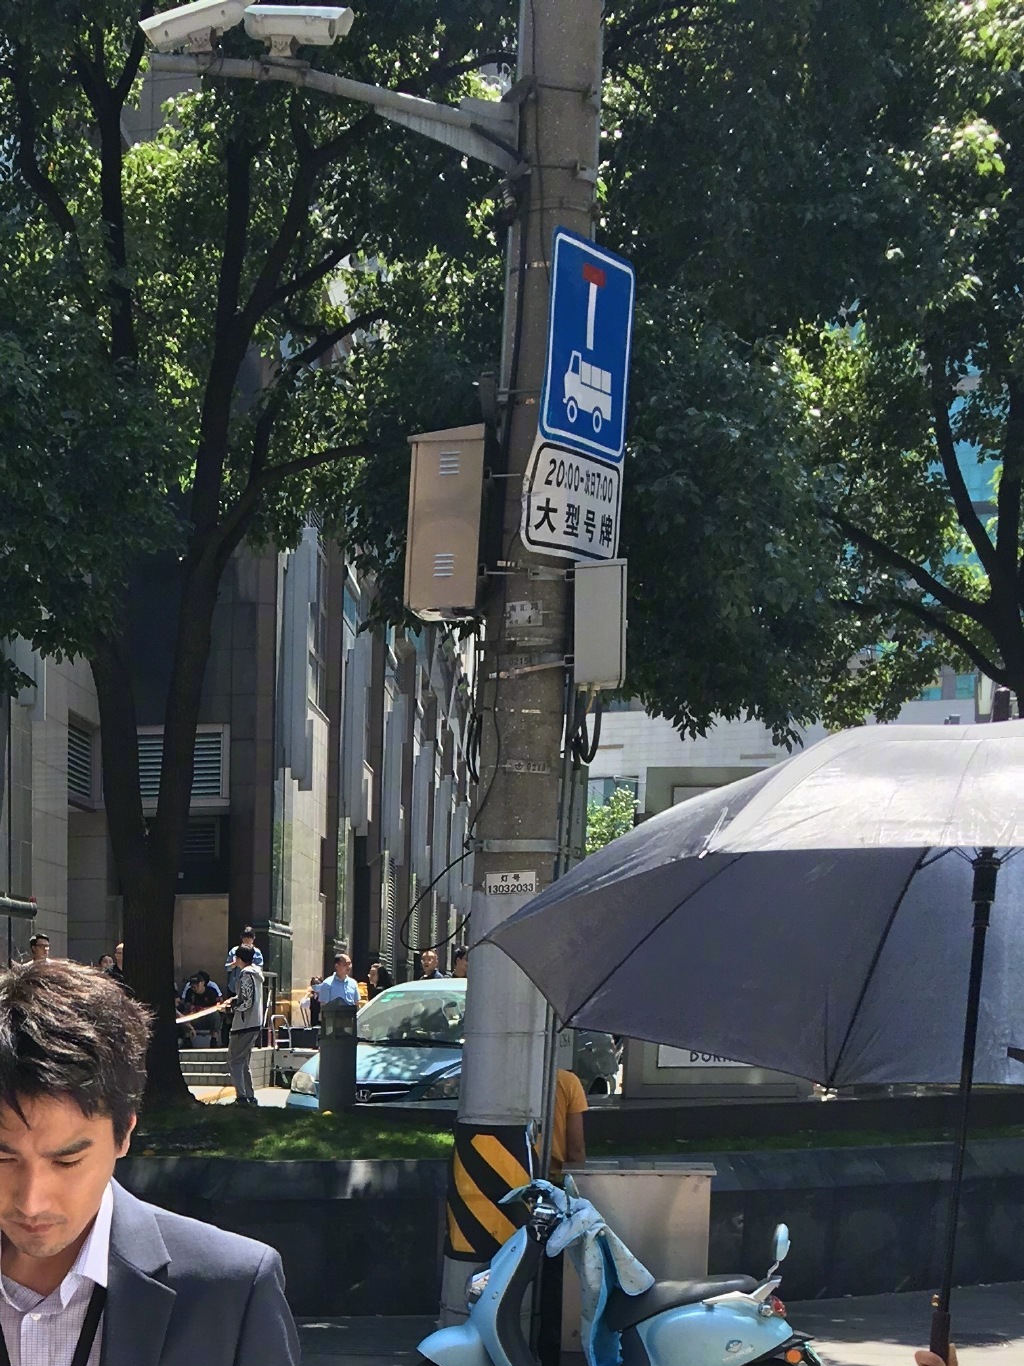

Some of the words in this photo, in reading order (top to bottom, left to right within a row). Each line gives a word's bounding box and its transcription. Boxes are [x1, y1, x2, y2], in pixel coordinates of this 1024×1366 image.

[533, 497, 614, 549] 大型号牌
[500, 873, 521, 883] 灯号
[487, 883, 534, 894] 13032033
